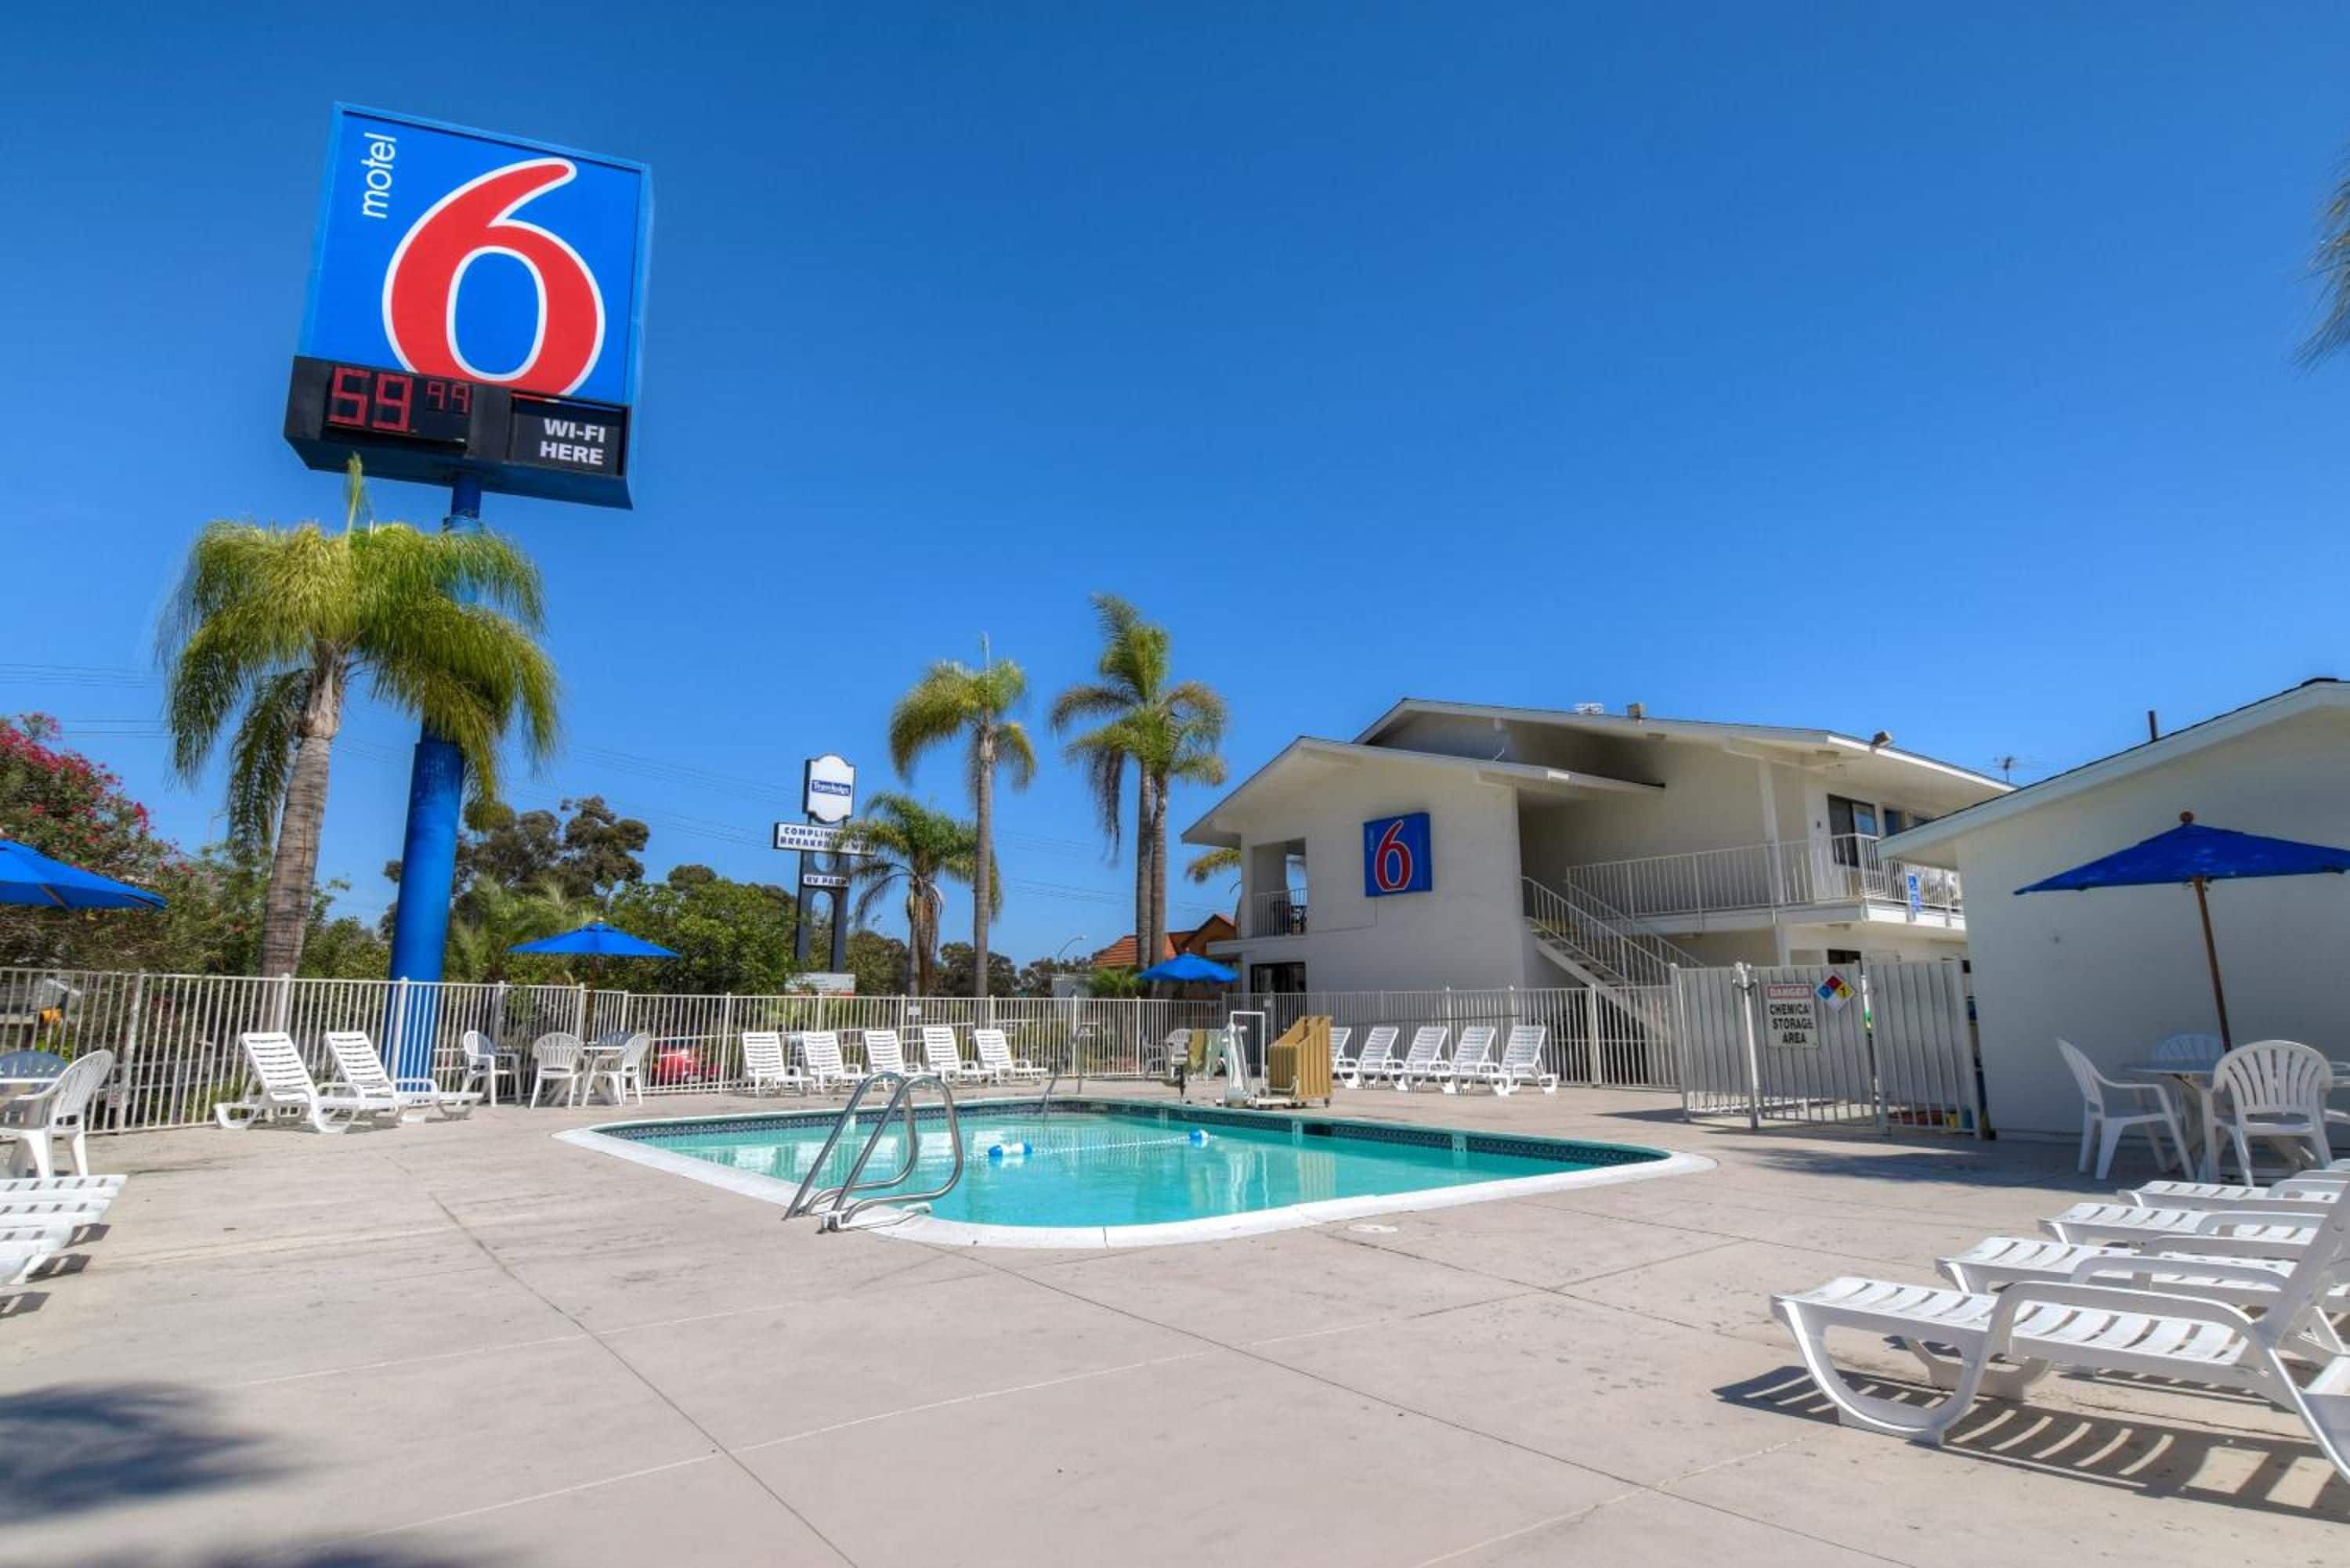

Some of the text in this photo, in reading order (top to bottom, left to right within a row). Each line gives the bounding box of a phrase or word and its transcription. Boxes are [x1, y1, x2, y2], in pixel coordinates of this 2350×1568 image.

[360, 132, 396, 219] motel
[382, 157, 606, 395] 6
[328, 367, 413, 432] 59
[540, 440, 603, 465] HERE
[544, 417, 606, 443] WI-FI
[1375, 819, 1413, 891] 6
[1773, 1017, 1813, 1029] STORAGE
[1783, 1032, 1806, 1044] AREA
